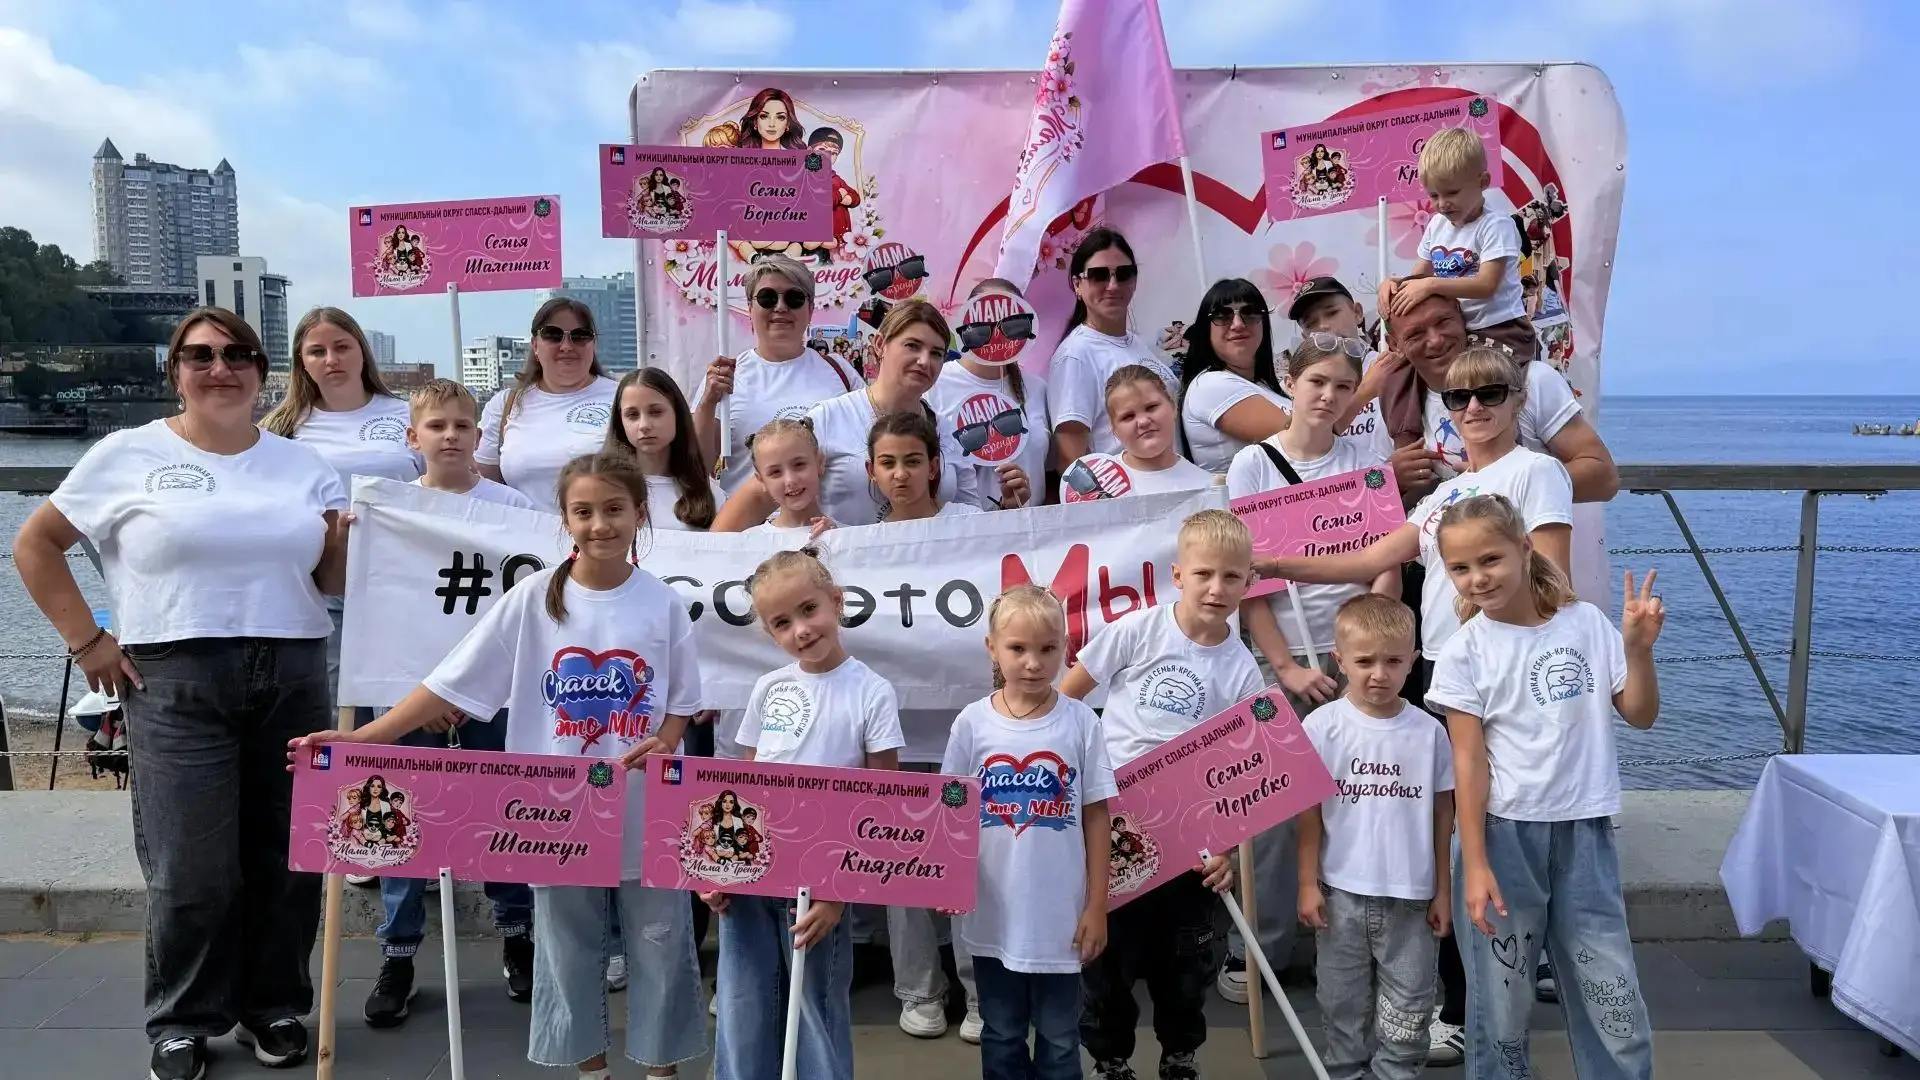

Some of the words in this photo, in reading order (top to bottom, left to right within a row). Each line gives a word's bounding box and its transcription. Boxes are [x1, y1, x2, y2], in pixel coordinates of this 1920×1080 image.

[1296, 120, 1365, 144] МУНИЦИПАЛЬНЫЙ
[1366, 117, 1390, 132] ОКРУГ
[1390, 104, 1461, 127] СПАССК-ДАЛЬНИЙ
[635, 152, 704, 165] МУНИЦИПАЛЬНЫЙ
[705, 154, 730, 165] ОКРУГ
[730, 155, 797, 167] СПАССК-ДАЛЬНИЙ
[749, 181, 797, 198] Семья
[380, 207, 442, 222] МУНИЦИПАЛЬНЫЙ
[442, 207, 465, 218] ОКРУГ
[465, 204, 527, 217] СПАССК-ДАЛЬНИЙ
[743, 204, 808, 226] Боровик
[484, 233, 529, 250] Семья
[465, 257, 551, 274] Шалегиных
[969, 298, 1020, 324] МАМА
[57, 389, 86, 402] moby
[1259, 497, 1283, 512] ОКРУГ
[1284, 477, 1358, 506] СПАССК-ДАЛЬНИЙ
[1312, 511, 1364, 532] Семья
[541, 667, 627, 707] Спасск
[555, 716, 601, 738] это
[1138, 758, 1165, 780] ОКРУГ
[1165, 713, 1246, 765] СПАССК-ДАЛЬНИЙ
[345, 753, 443, 774] МУНИЦИПАЛЬНЫЙ
[445, 759, 478, 775] ОКРУГ
[479, 761, 576, 780] СПАССК-ДАЛЬНИЙ
[1206, 752, 1264, 789] Семья
[1351, 757, 1402, 776] Семья
[696, 768, 795, 789] МУНИЦИПАЛЬНЫЙ
[797, 776, 831, 791] ОКРУГ
[832, 779, 931, 799] СПАССК-ДАЛЬНИЙ
[1215, 773, 1290, 817] Черевко
[503, 798, 573, 823] Семья
[986, 802, 1022, 815] это
[856, 817, 927, 842] Семья
[334, 843, 368, 858] Мама
[379, 845, 411, 860] Тренде
[488, 830, 589, 866] Шапкун
[686, 860, 720, 874] Мама
[732, 860, 764, 877] Тренде
[839, 850, 946, 884] Князевых
[1109, 874, 1126, 890] ама
